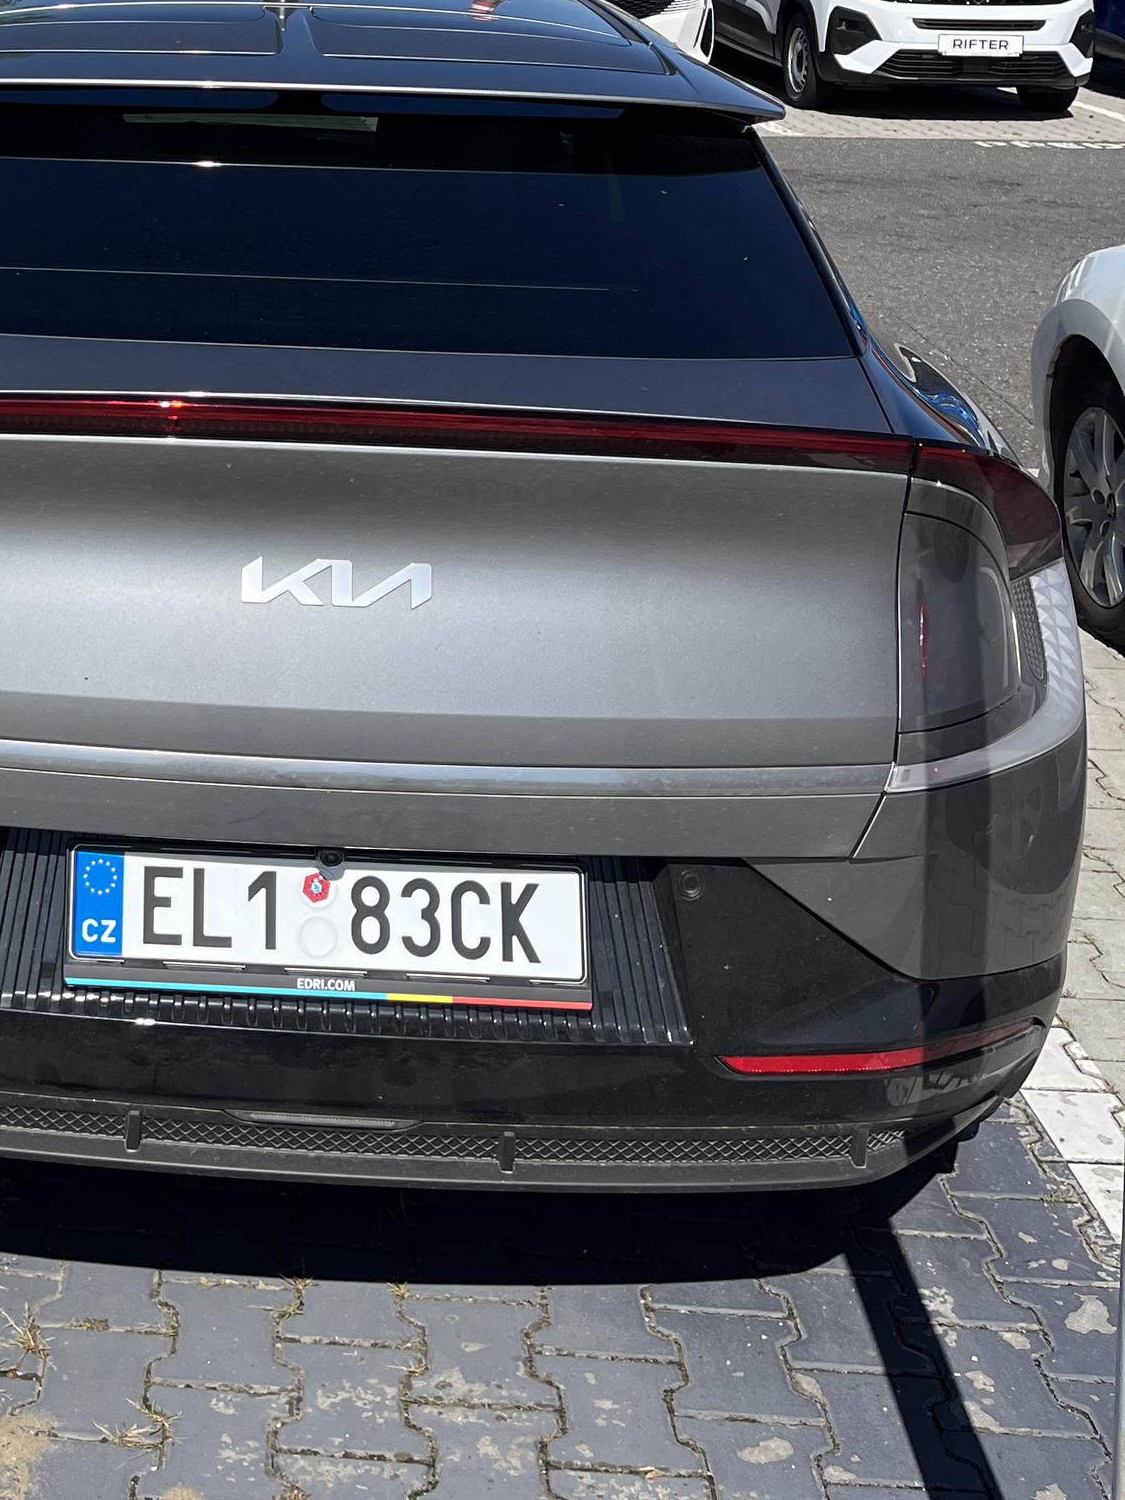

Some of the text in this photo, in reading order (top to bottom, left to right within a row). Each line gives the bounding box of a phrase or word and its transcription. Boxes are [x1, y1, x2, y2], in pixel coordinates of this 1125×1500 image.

[952, 38, 1009, 50] RIFTER
[143, 866, 541, 964] EL1 83CK
[82, 918, 117, 943] CZ
[296, 977, 356, 992] EDRI.COM
